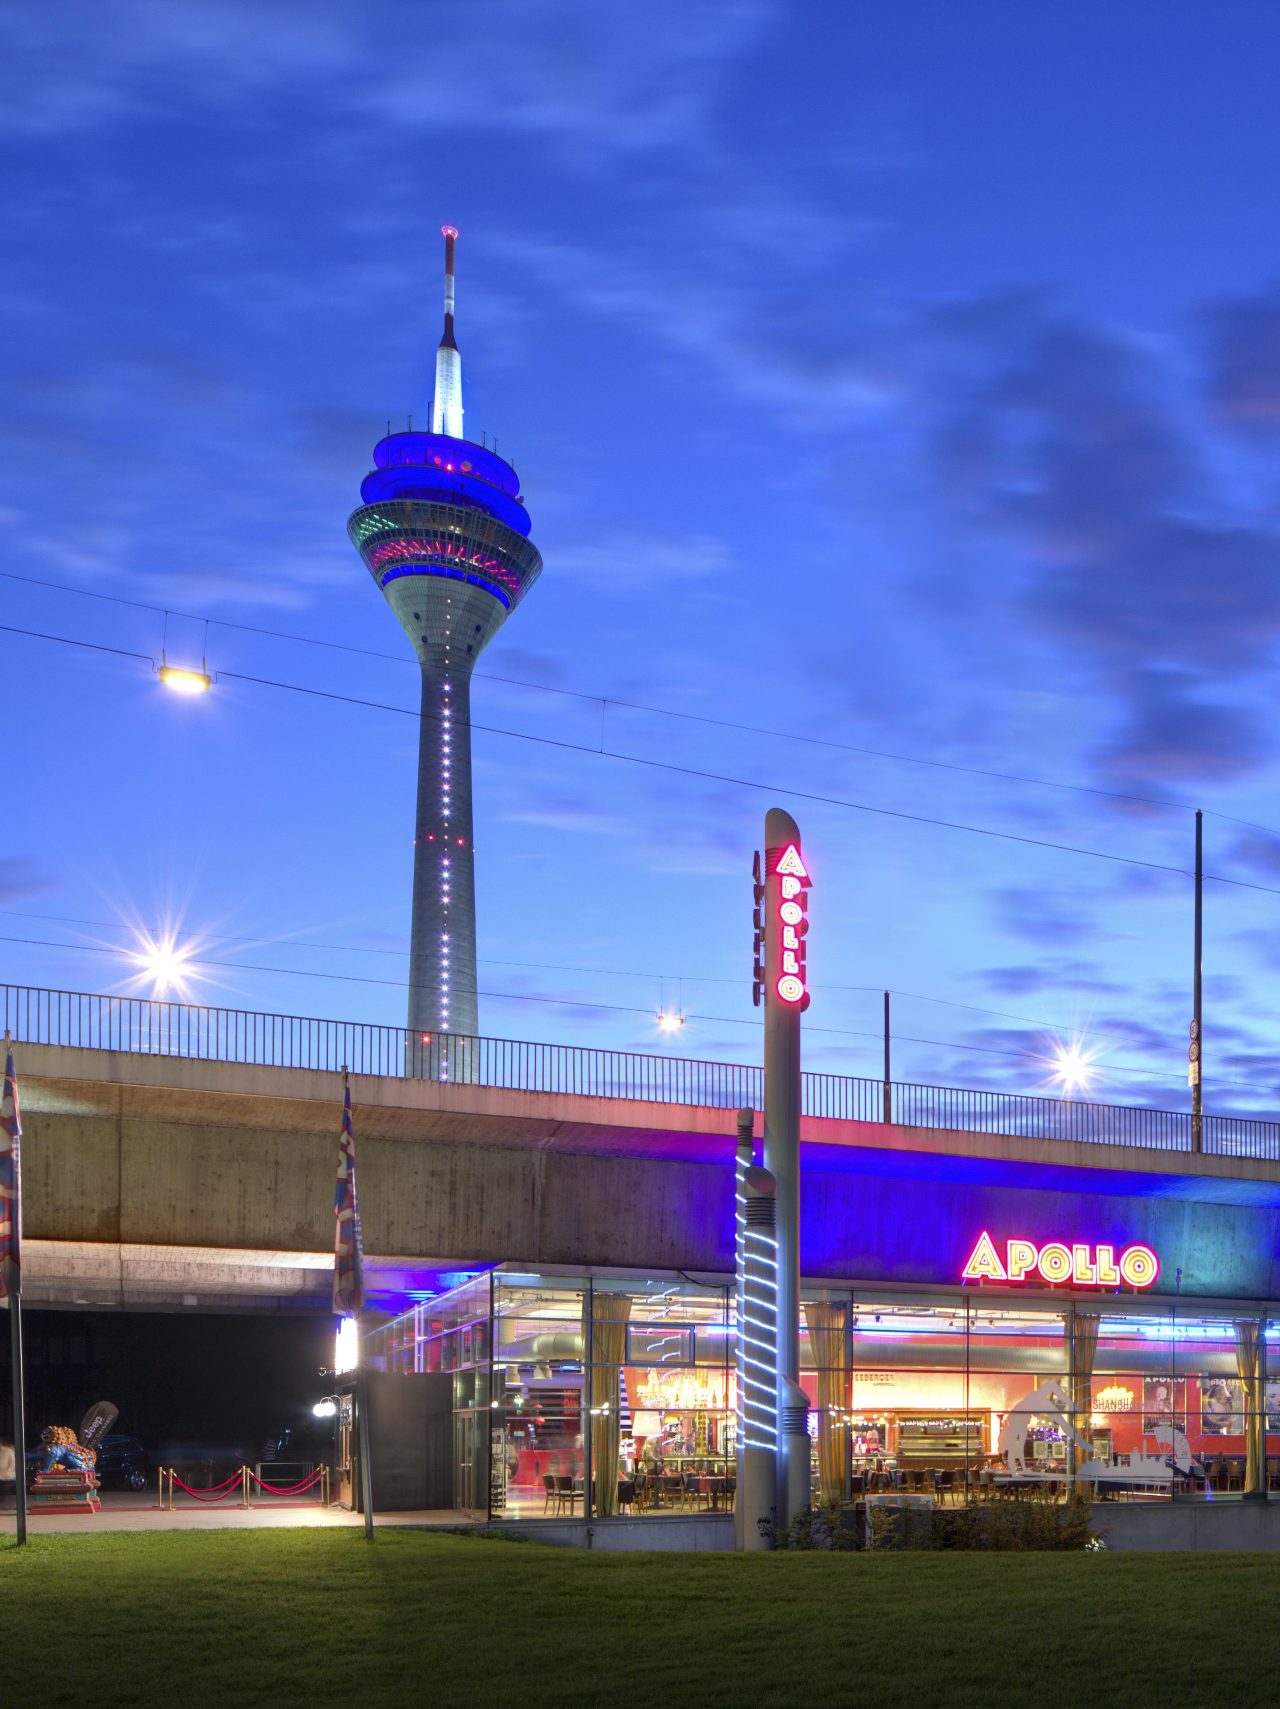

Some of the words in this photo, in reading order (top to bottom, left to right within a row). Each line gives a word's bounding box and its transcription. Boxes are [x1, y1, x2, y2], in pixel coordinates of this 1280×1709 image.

[776, 844, 807, 1002] APOLLO
[961, 1230, 1158, 1287] APOLLO
[85, 1416, 103, 1438] Jeep
